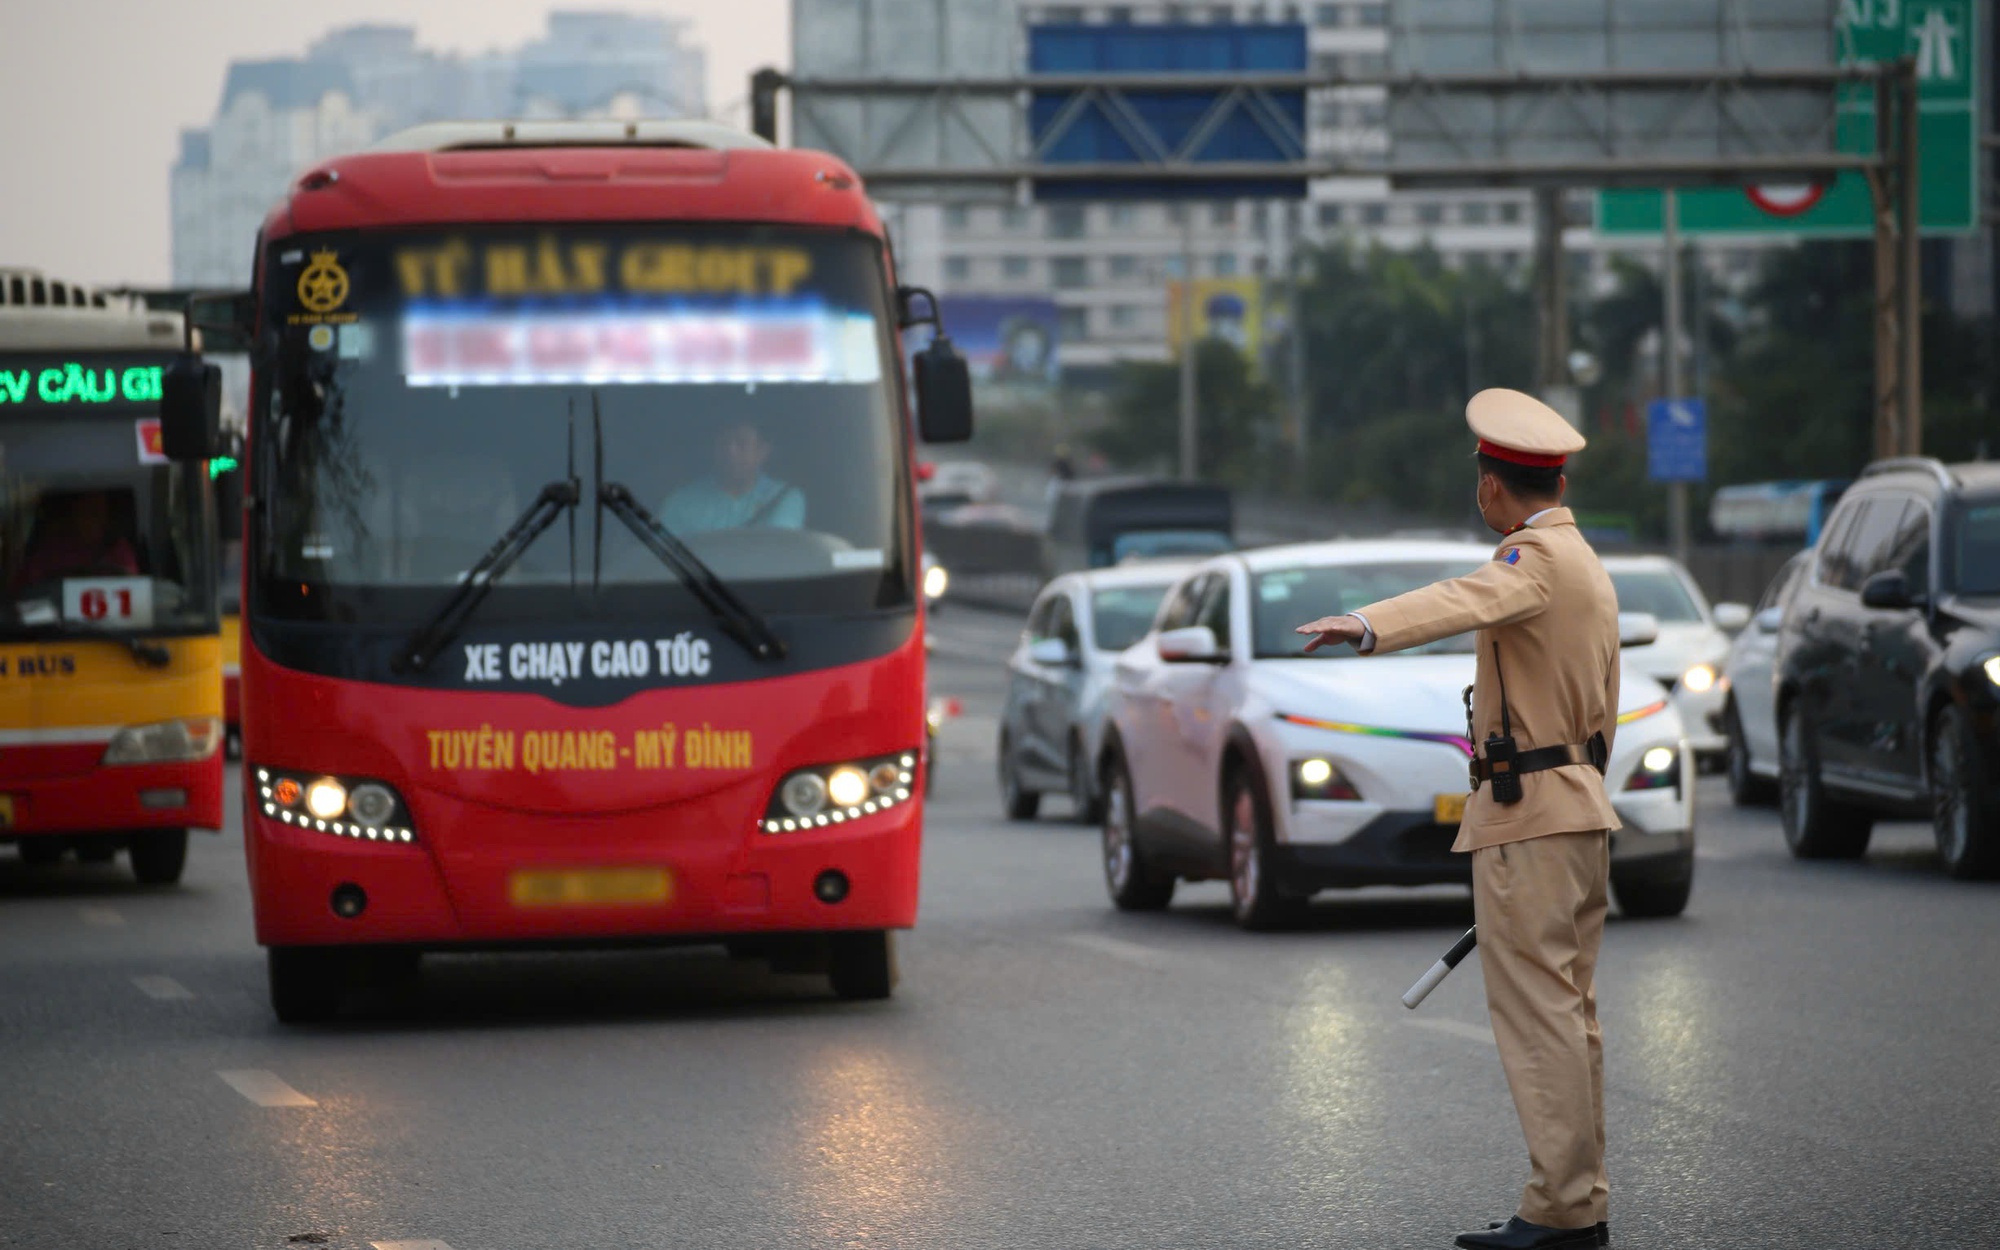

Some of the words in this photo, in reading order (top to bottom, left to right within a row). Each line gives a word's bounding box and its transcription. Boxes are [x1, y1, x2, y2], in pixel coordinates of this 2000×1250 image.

[120, 366, 164, 402] GI
[80, 588, 132, 620] 61
[464, 643, 502, 682] XE
[509, 642, 585, 687] CHẠY
[591, 639, 649, 678] CAO
[654, 630, 711, 677] TỐC
[426, 722, 514, 770] TUYÊN
[521, 730, 617, 774] QUANG
[634, 721, 677, 770] MỸ
[684, 721, 752, 770] ĐÌNH
